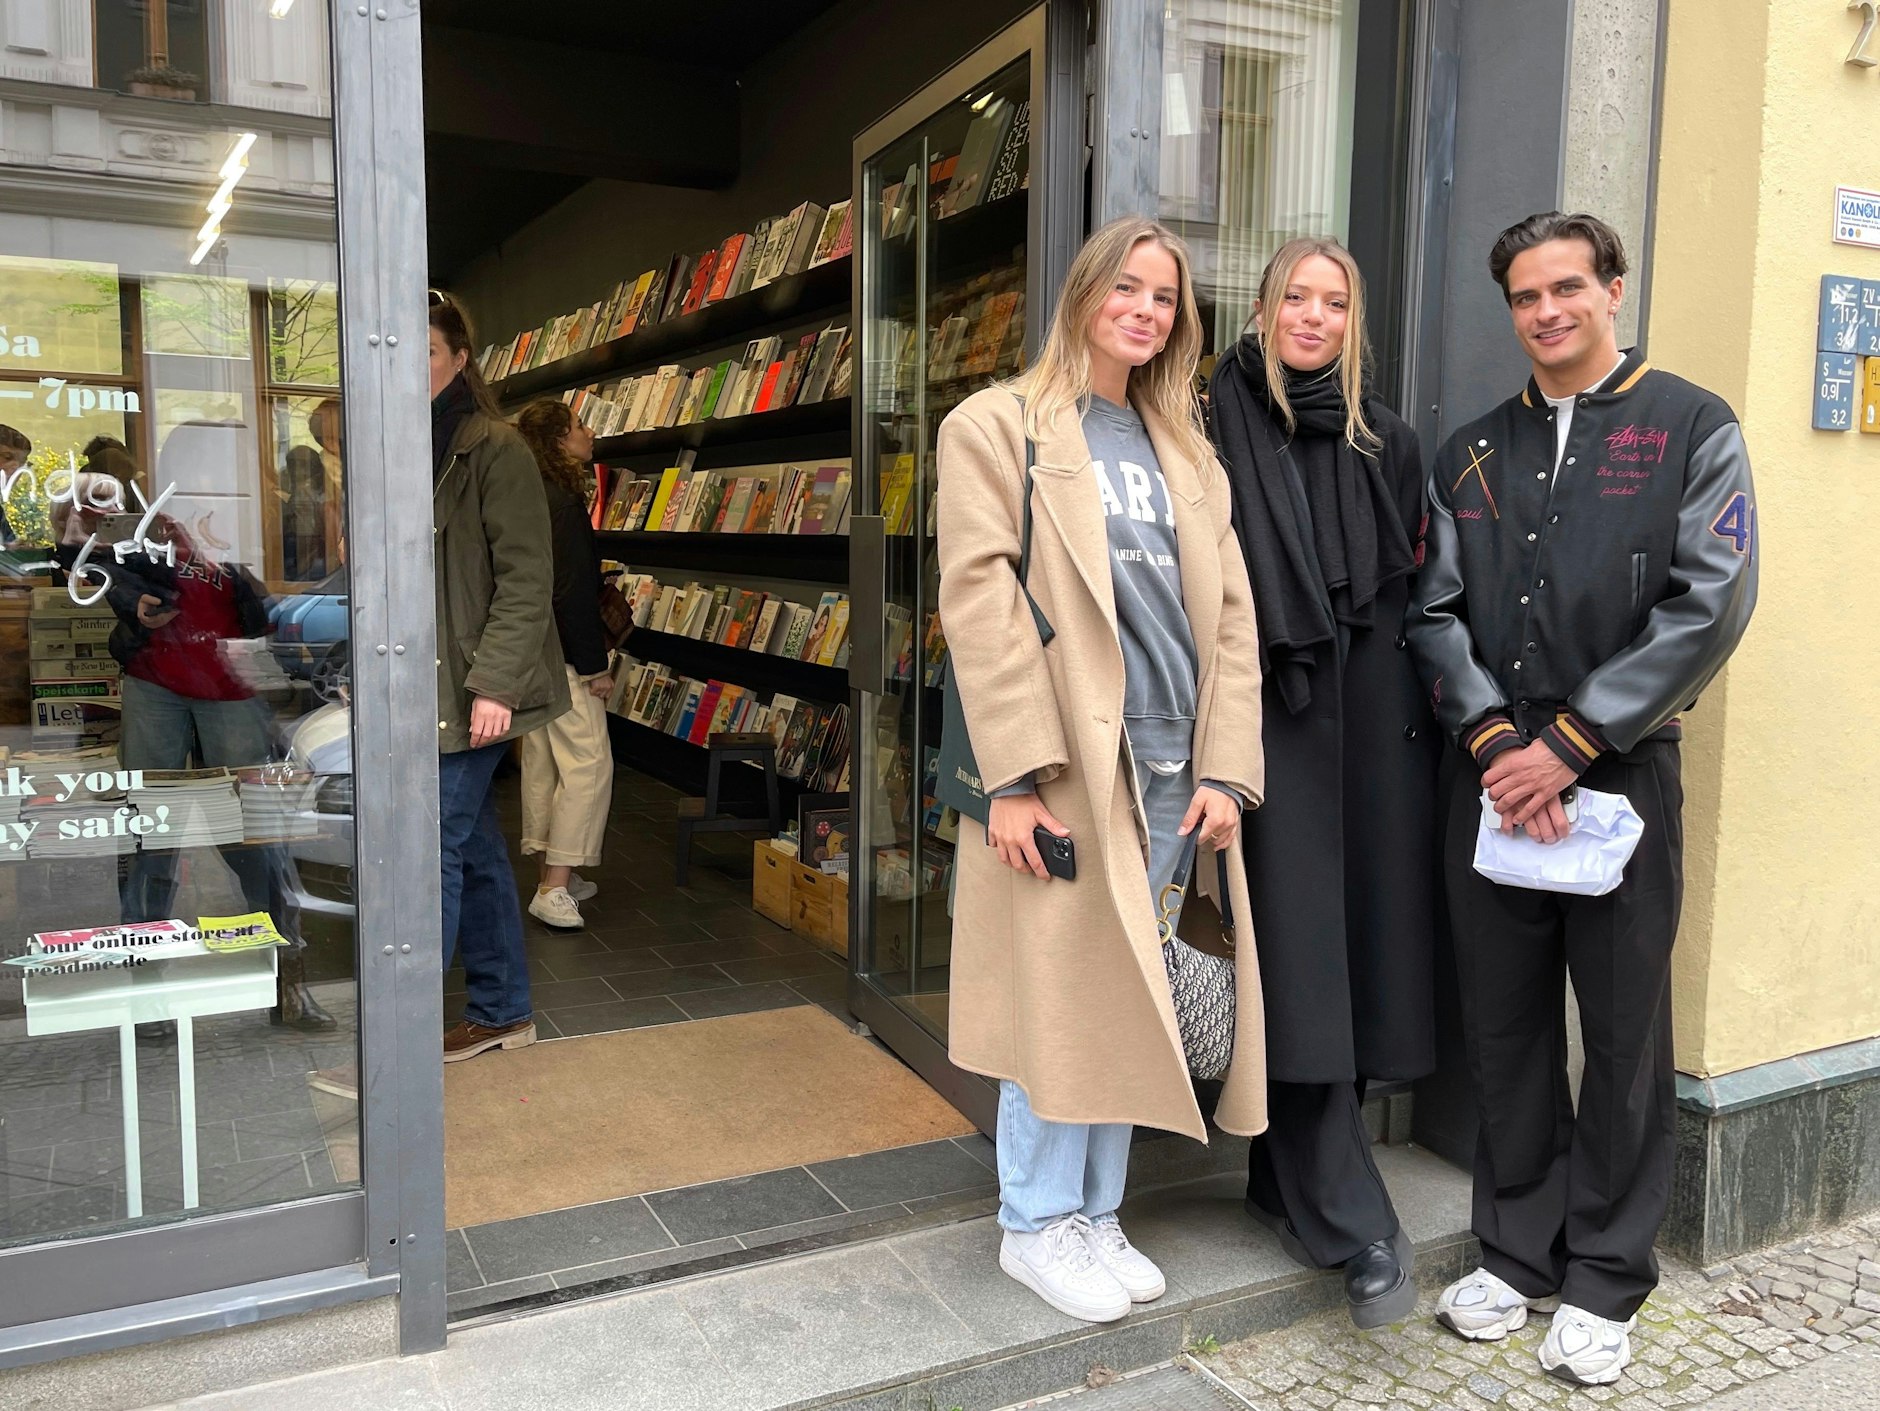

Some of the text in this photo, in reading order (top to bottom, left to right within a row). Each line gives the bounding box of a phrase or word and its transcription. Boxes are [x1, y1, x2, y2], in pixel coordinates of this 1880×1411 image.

[1845, 0, 1880, 68] 2
[1831, 408, 1847, 426] 3,2
[0, 767, 145, 802] k you
[58, 804, 171, 841] safe!
[92, 932, 164, 949] online
